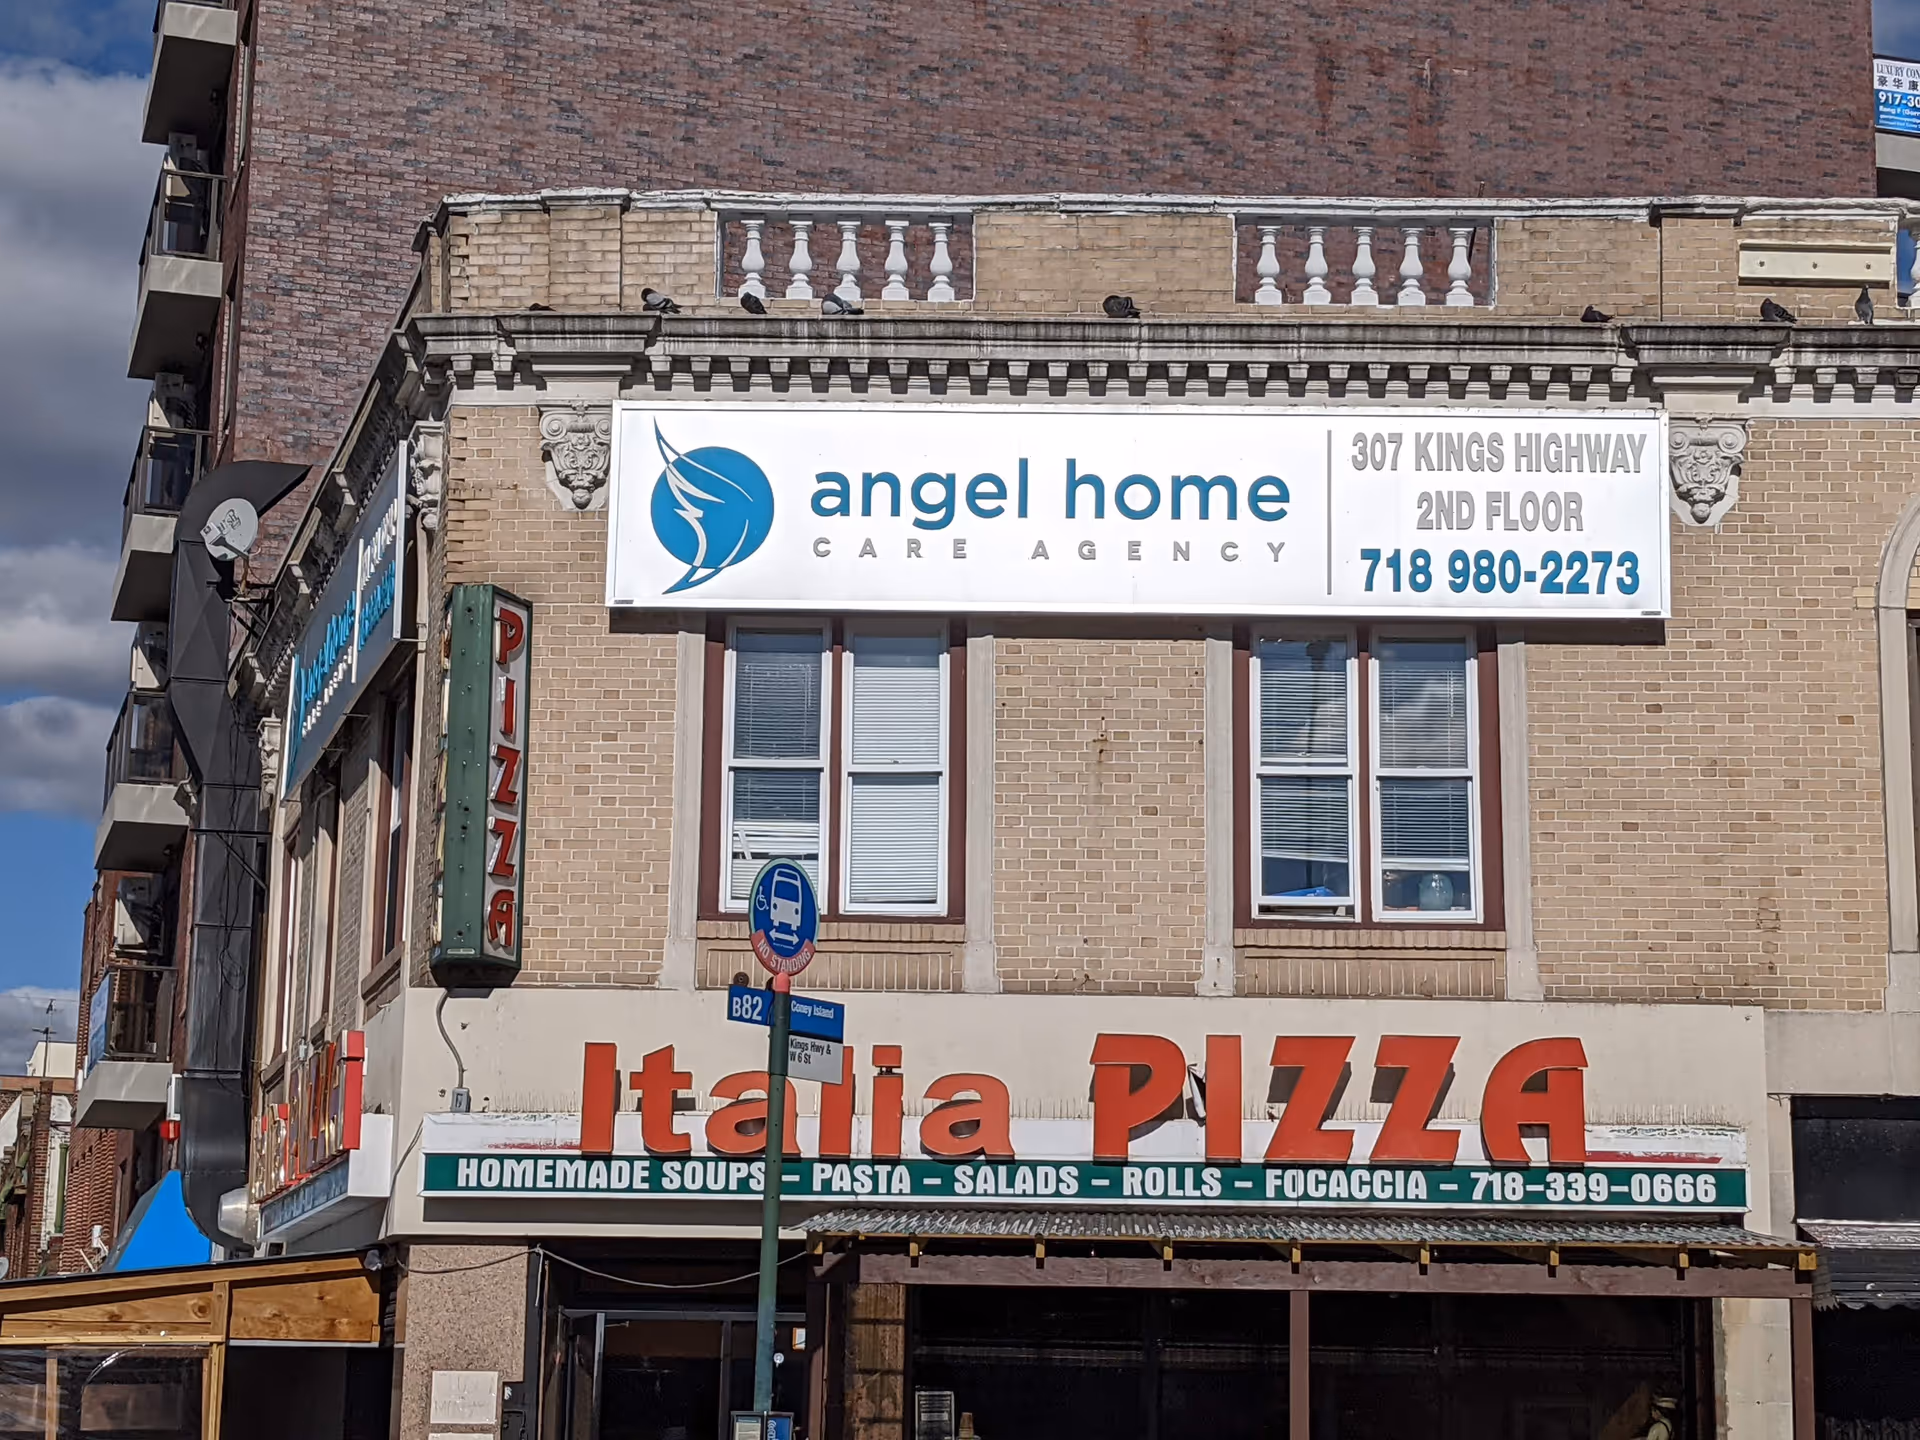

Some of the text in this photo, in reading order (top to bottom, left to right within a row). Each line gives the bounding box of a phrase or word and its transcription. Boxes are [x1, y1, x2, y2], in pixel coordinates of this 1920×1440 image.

[1876, 63, 1905, 77] LUXURY
[1351, 432, 1647, 473] 307 KINGS HIGHWAY
[811, 458, 1290, 530] angel home
[1416, 490, 1584, 532] 2ND FLOOR
[813, 537, 1286, 563] CARE AGENCY
[1360, 548, 1640, 595] 718 980-2273
[487, 607, 525, 948] PIZZA
[757, 938, 812, 972] NO STANDING
[732, 994, 763, 1021] B82
[790, 1000, 834, 1019] Coney Island
[790, 1037, 832, 1056] Kings Hwy &
[790, 1051, 811, 1064] W 6 St
[579, 1033, 1589, 1163] Italia PIZZA
[457, 1157, 650, 1191] HOMEMADE
[661, 1161, 766, 1192] SOUPS
[813, 1163, 912, 1195] PASTA
[953, 1165, 1079, 1196] SALADS
[1122, 1167, 1222, 1197] ROLLS
[1265, 1169, 1427, 1200] FOCACCIA
[1469, 1171, 1717, 1204] 718-339-0666
